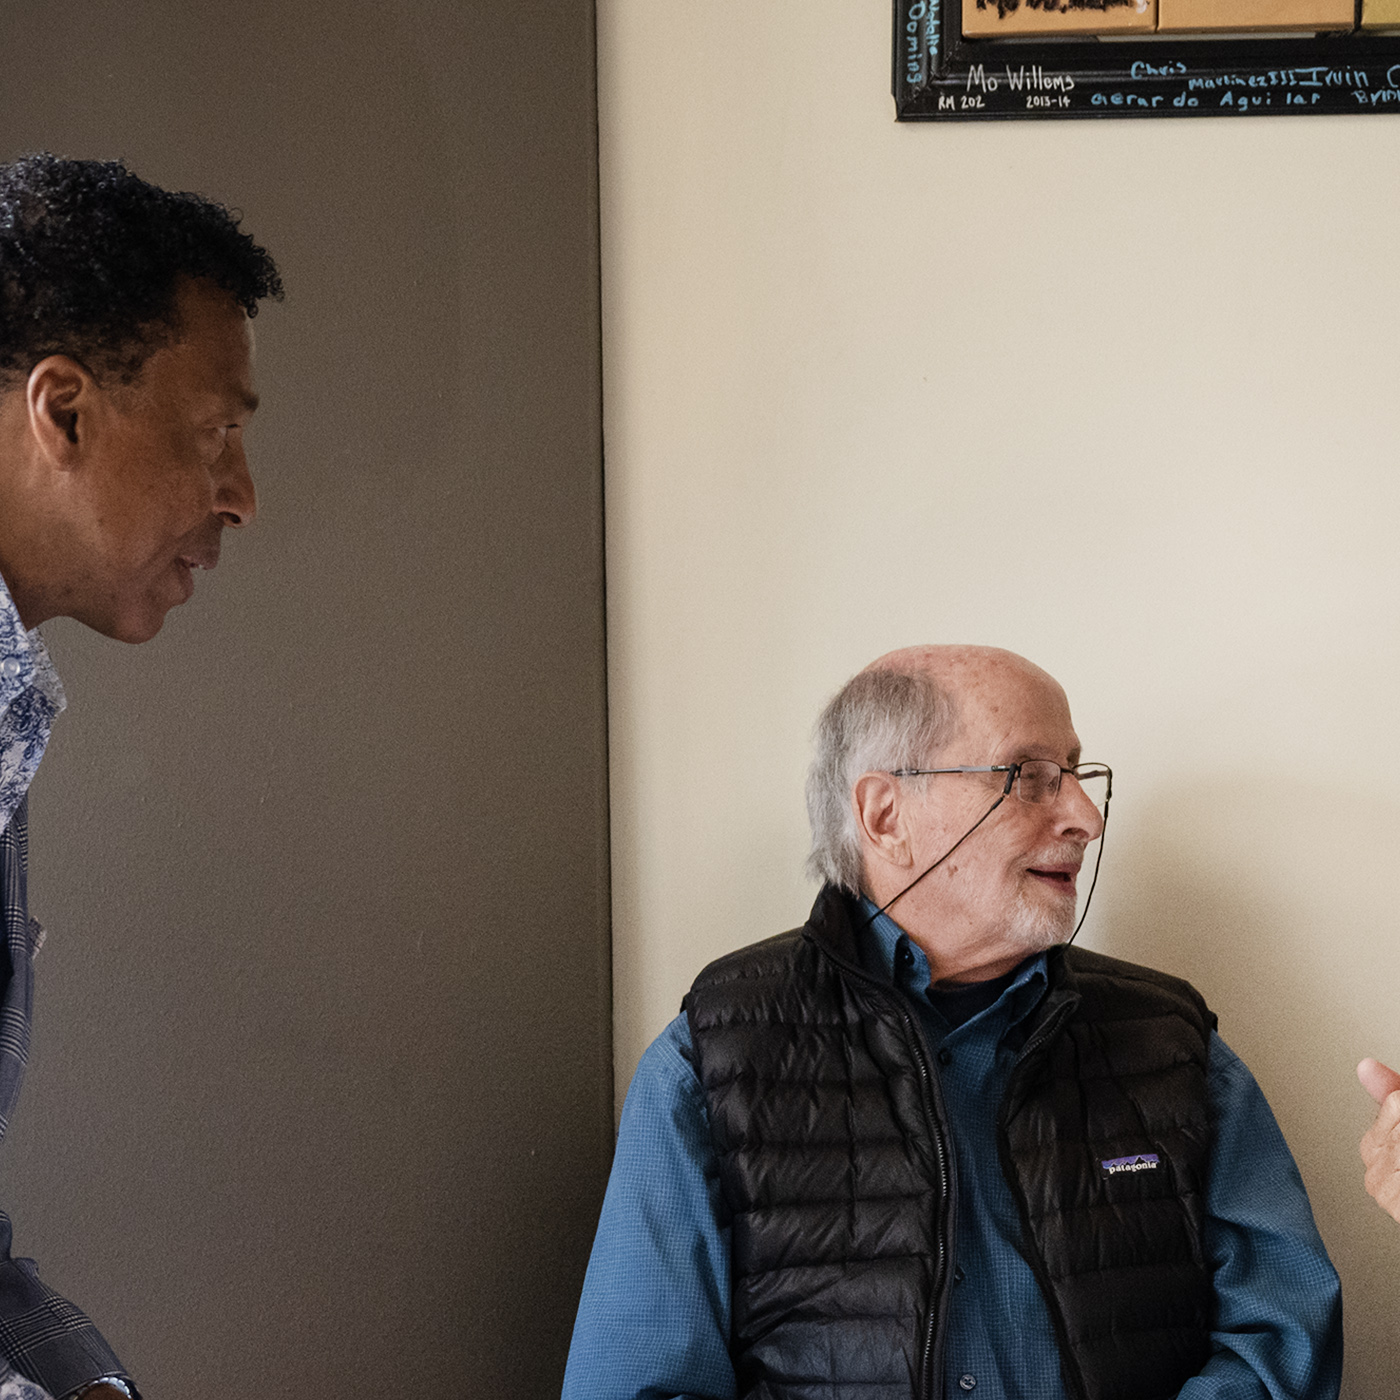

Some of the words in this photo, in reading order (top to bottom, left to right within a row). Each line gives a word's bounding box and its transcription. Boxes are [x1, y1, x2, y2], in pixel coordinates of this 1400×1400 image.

[966, 63, 998, 93] Mo
[1130, 61, 1188, 81] Chris
[938, 95, 956, 111] RM
[960, 95, 986, 110] 202
[1108, 1161, 1157, 1174] patagonia
